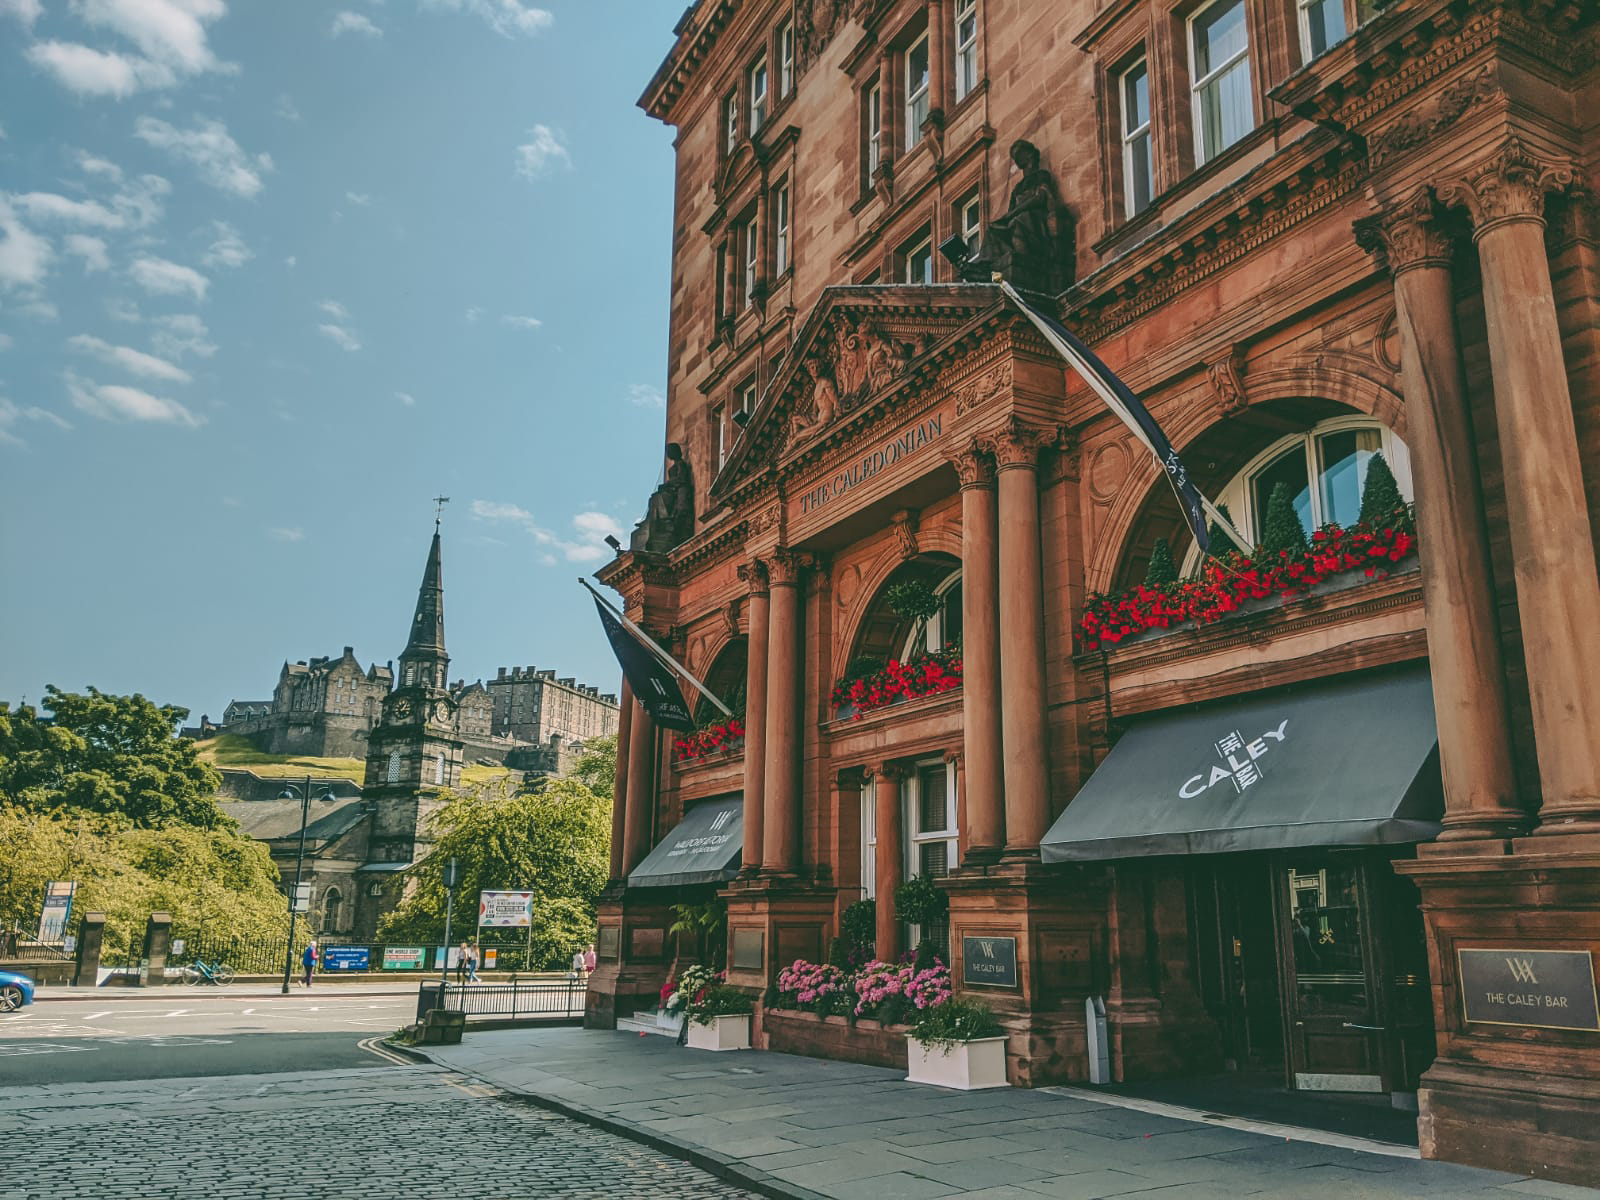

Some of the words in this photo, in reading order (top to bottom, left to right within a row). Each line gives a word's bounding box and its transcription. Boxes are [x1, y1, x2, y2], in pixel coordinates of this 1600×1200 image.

[800, 482, 830, 513] THE
[831, 413, 942, 496] CALEDONIAN
[1218, 731, 1242, 756] THE
[1178, 719, 1288, 799] CALEY
[1235, 764, 1258, 790] BAR
[981, 964, 994, 973] CALEY
[1486, 992, 1504, 1004] THE
[1507, 993, 1541, 1007] CALEY
[1545, 996, 1568, 1008] BAR
